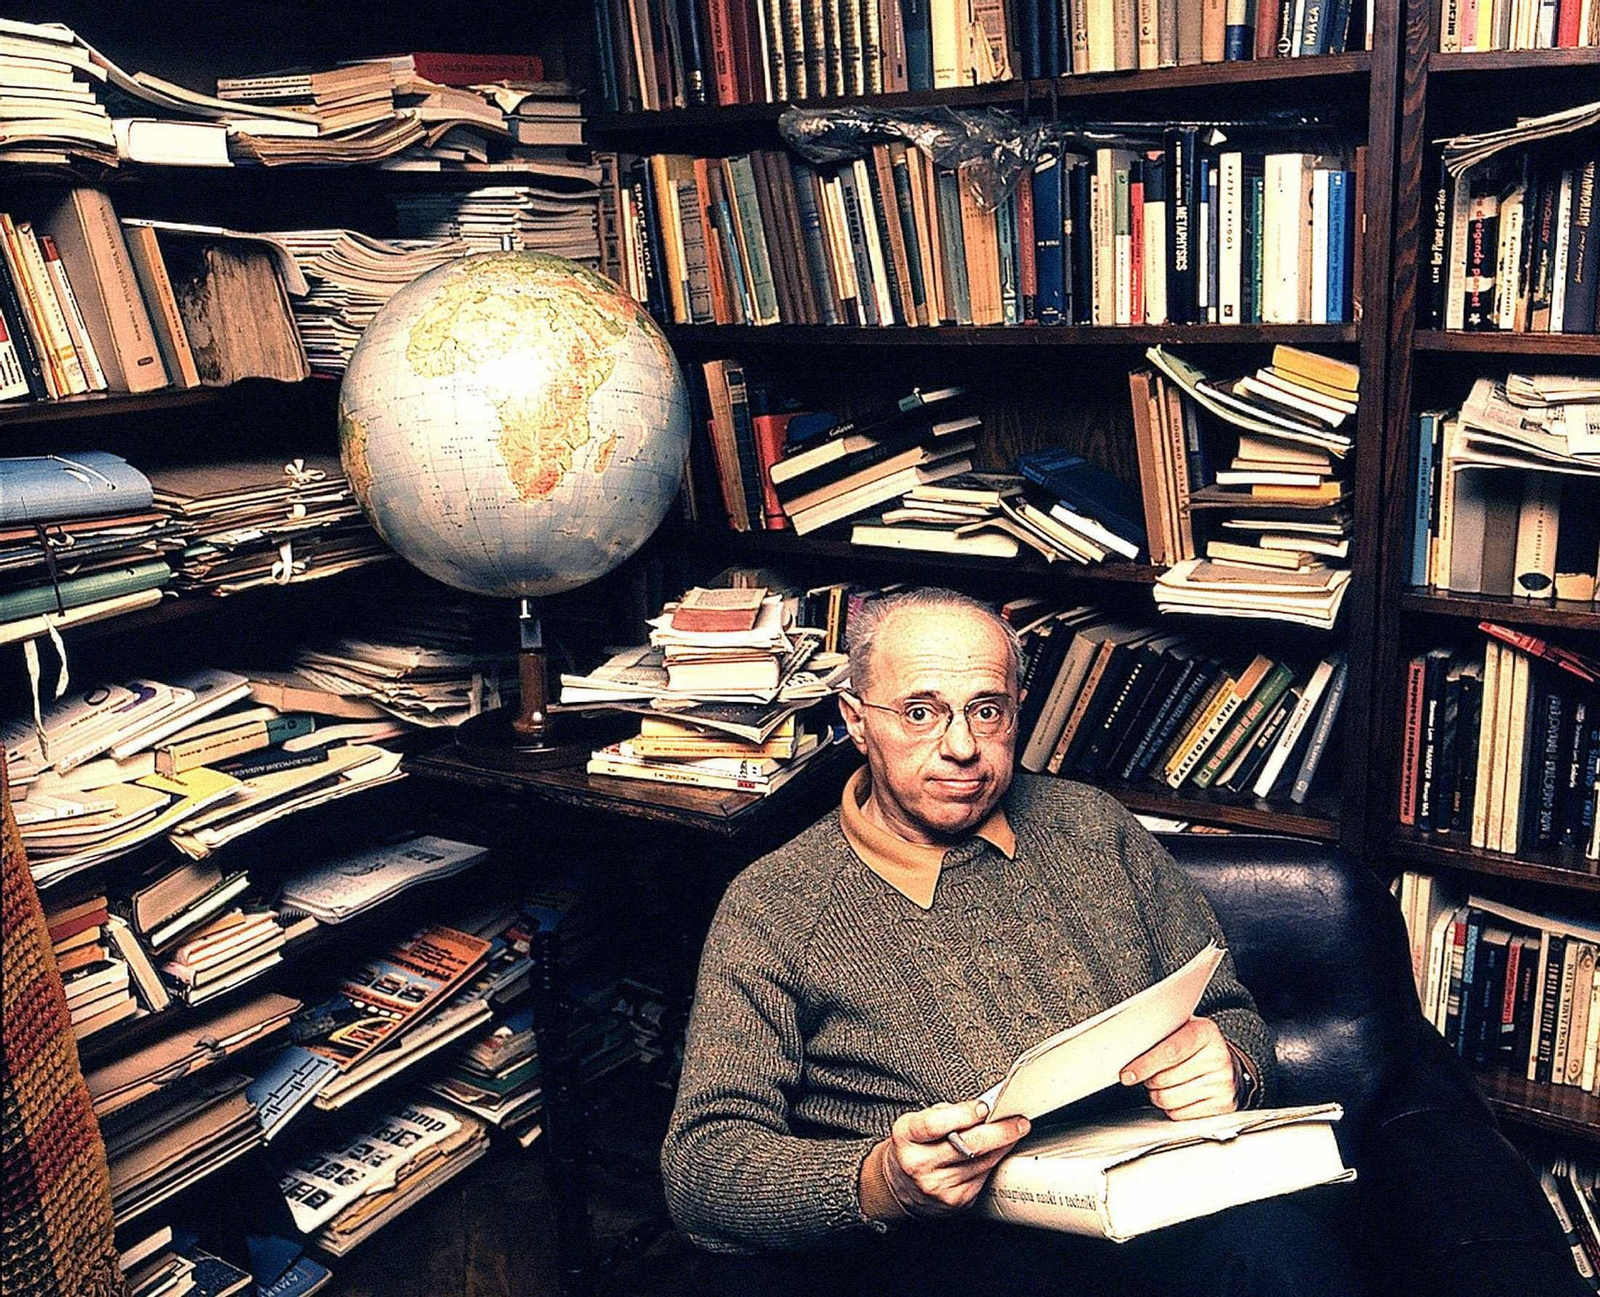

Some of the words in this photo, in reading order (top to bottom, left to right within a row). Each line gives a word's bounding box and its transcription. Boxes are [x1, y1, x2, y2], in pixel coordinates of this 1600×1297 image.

[1174, 206, 1188, 271] METAPHYSICS
[1471, 210, 1484, 264] dreigende
[1431, 267, 1440, 283] LEM
[1470, 267, 1481, 306] planeet
[1206, 725, 1217, 735] К
[1423, 744, 1434, 779] TRANSFER
[1568, 762, 1578, 788] Solaris
[1560, 997, 1570, 1025] ZAMEK
[1034, 1188, 1057, 1205] nauki
